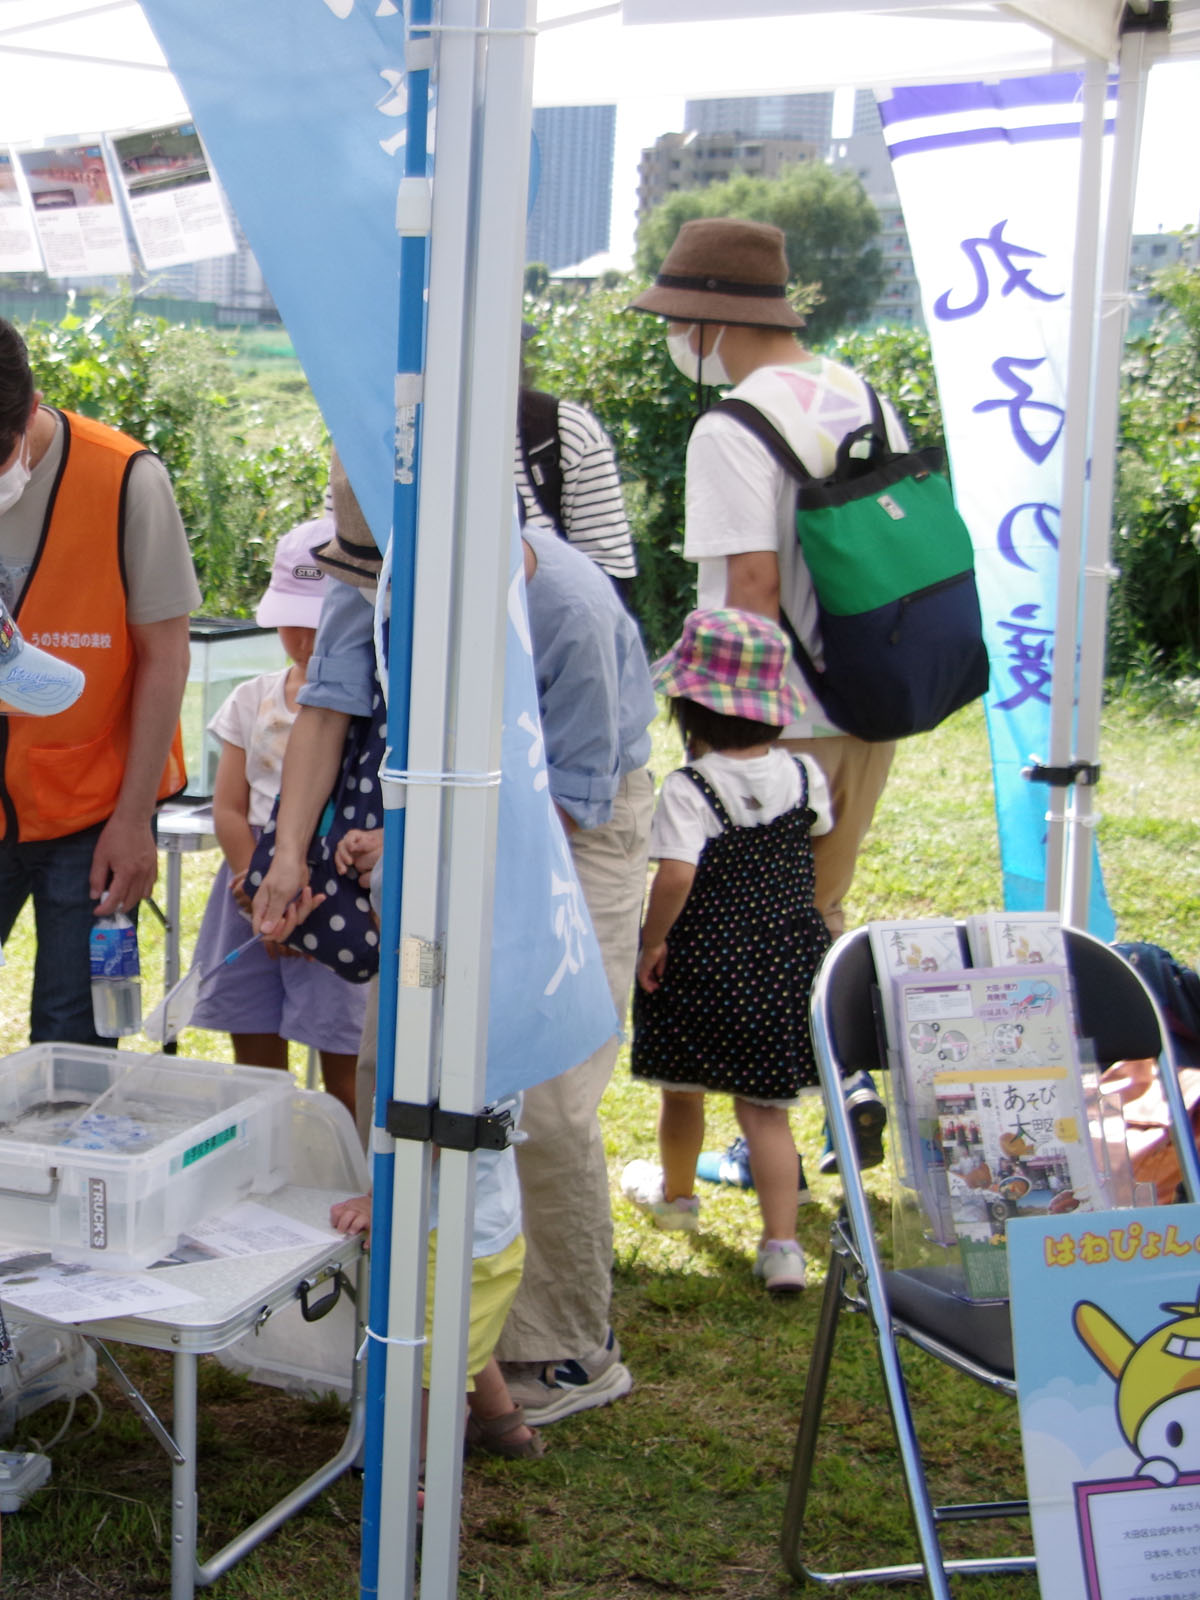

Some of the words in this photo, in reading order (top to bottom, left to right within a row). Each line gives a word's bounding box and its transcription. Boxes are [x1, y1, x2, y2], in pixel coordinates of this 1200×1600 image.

[1003, 1084, 1056, 1112] あそび
[93, 1181, 106, 1247] TRUCK'S
[1044, 1222, 1200, 1267] はねぴょん
